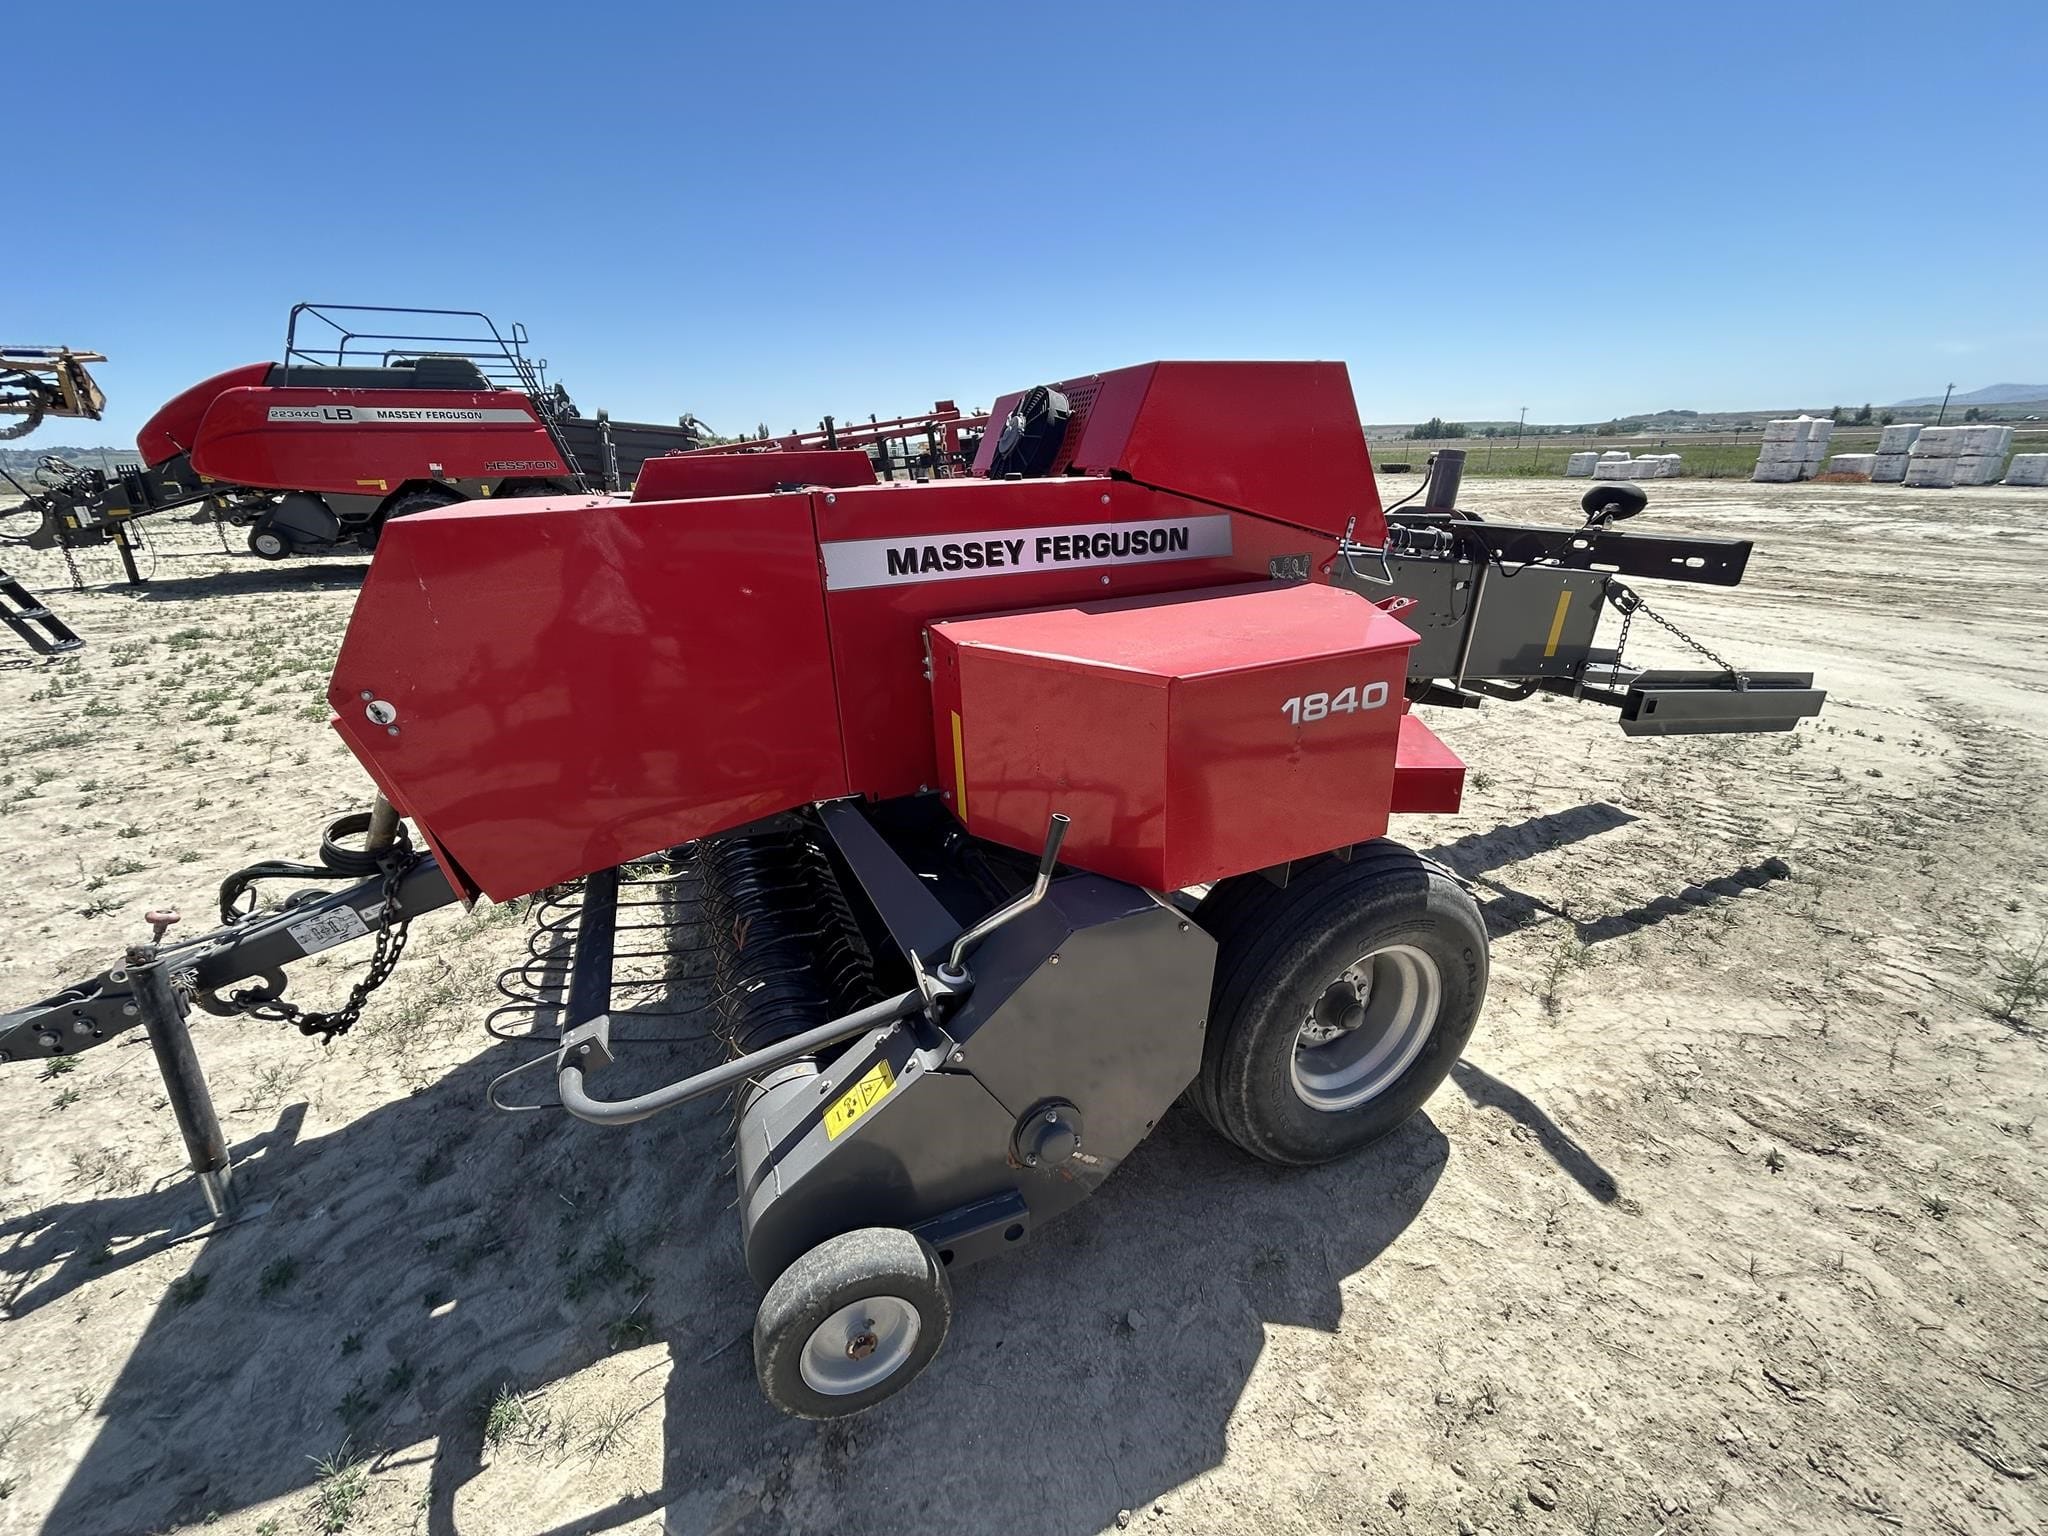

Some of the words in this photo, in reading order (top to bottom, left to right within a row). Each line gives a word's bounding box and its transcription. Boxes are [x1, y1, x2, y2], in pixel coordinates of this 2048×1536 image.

[322, 408, 354, 421] LB
[376, 410, 422, 419] MASSEY
[426, 411, 482, 419] FERGUSON
[484, 460, 558, 471] HESSTON
[886, 538, 1026, 577] MASSEY
[1035, 526, 1190, 564] FERGUSON
[1281, 681, 1389, 725] 1840
